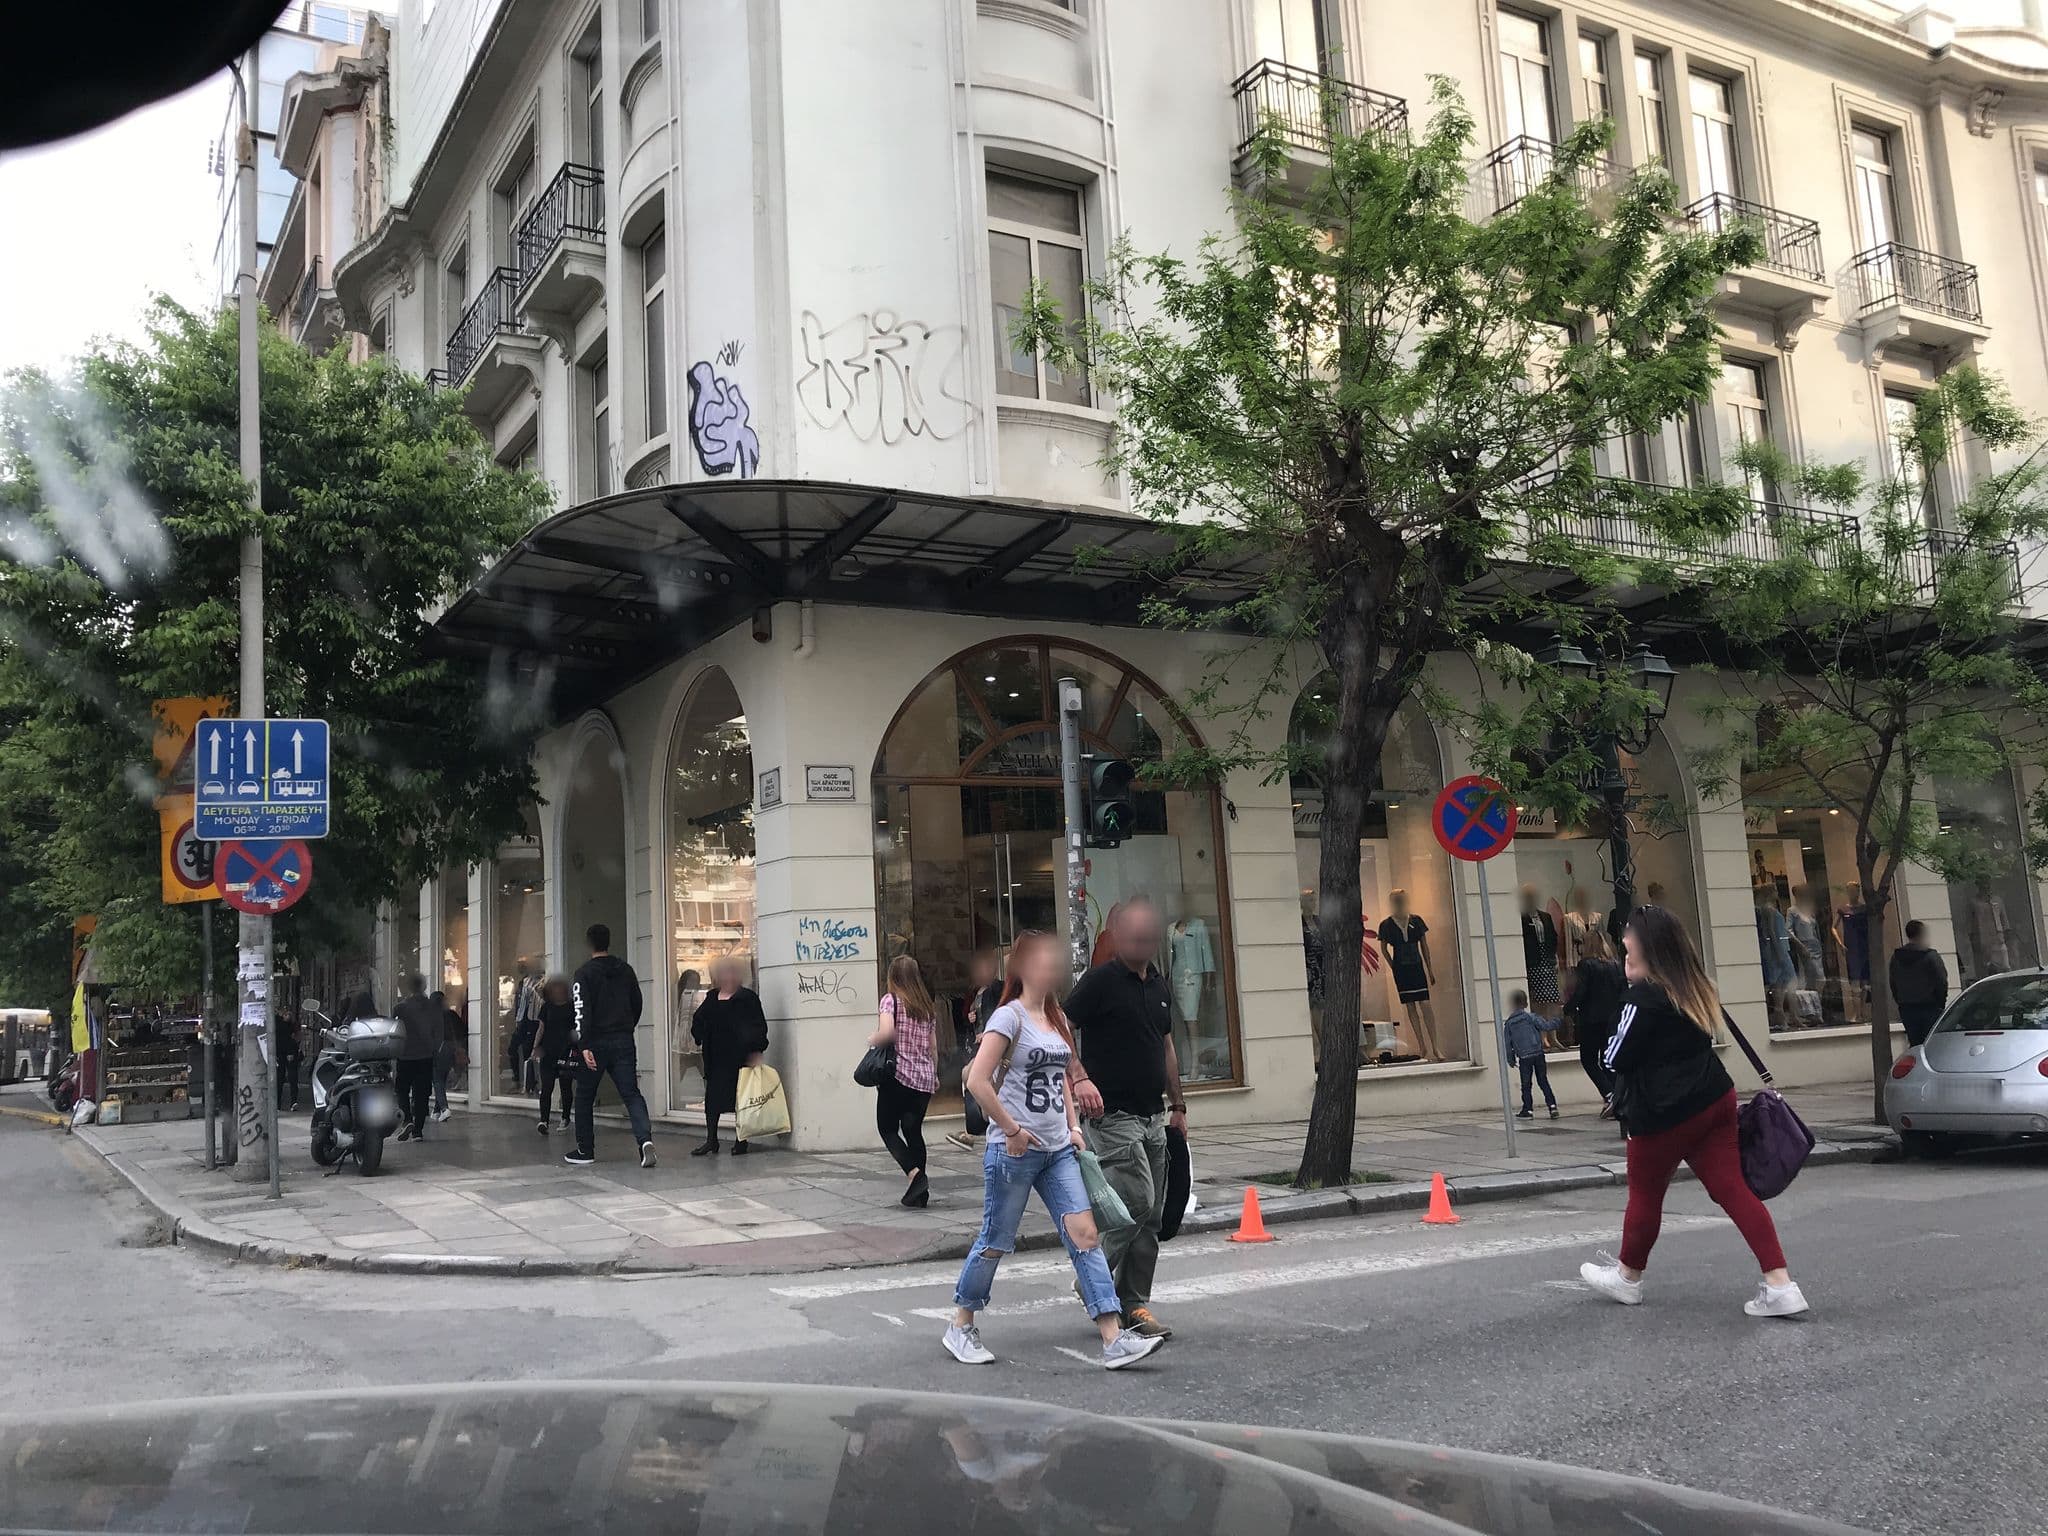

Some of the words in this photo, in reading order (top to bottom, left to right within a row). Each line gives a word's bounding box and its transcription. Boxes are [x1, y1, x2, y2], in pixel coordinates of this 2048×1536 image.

[203, 807, 252, 816] ΔΕΥΤΕΡΑ
[261, 806, 322, 815] ΠΑΡΑΣΚΕΥΗ
[214, 816, 260, 825] MONDAY
[276, 815, 311, 824] FRIDAY
